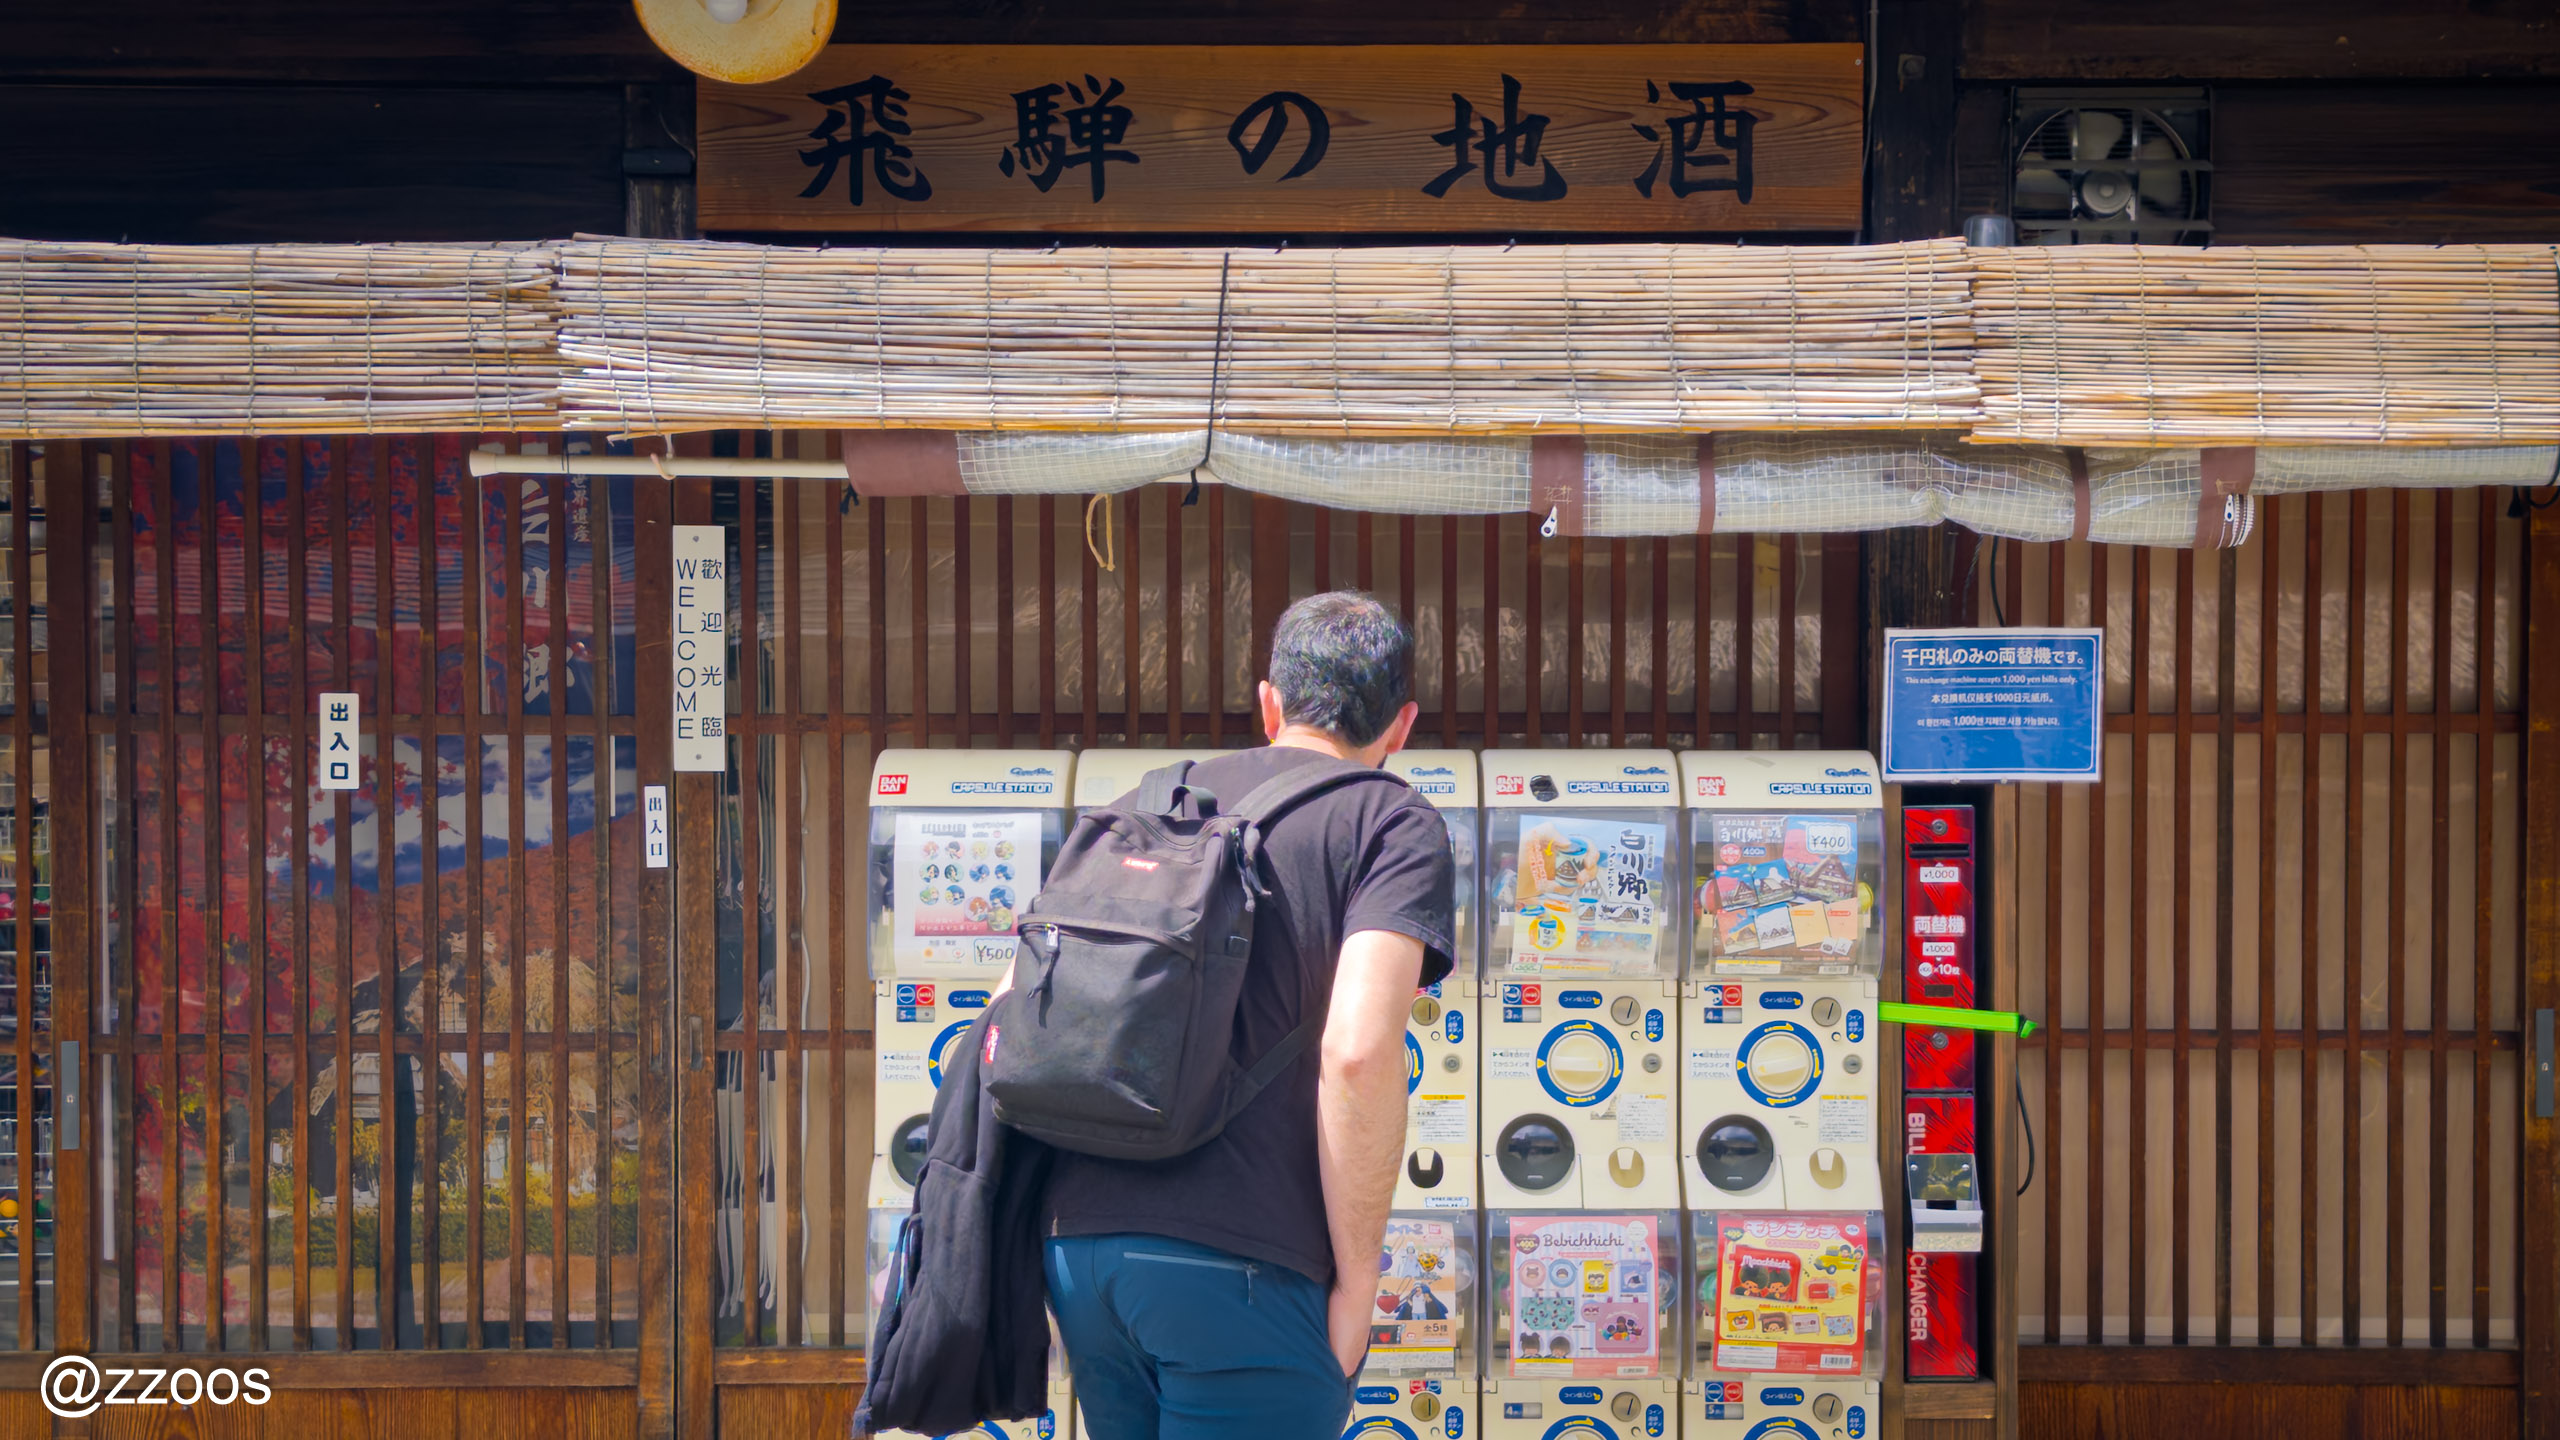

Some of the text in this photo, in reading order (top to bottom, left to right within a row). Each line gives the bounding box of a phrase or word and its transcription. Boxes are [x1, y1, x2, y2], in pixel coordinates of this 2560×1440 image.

[676, 558, 697, 739] WELCOME
[701, 558, 723, 738] 歡迎光臨
[1901, 647, 2084, 666] 千円札のみの両替機です。
[1905, 674, 2078, 685] This exchange machine accepts 1,000 yen bills only.
[329, 702, 350, 780] 出入口
[952, 782, 1052, 793] CAPSULE STATION
[1568, 782, 1669, 793] CAPSULE STATION
[1770, 783, 1872, 794] CAPSULE STATION
[648, 796, 663, 856] 出入口
[1811, 835, 1846, 849] ¥400
[1618, 829, 1648, 900] 白川郷
[1914, 915, 1965, 935] 両替機
[976, 945, 1015, 962] ¥500
[1908, 1112, 1926, 1154] BILL
[1542, 1232, 1625, 1247] Bebichhichi
[1744, 1220, 1839, 1240] モンチッチ
[1909, 1253, 1928, 1341] CHANGER
